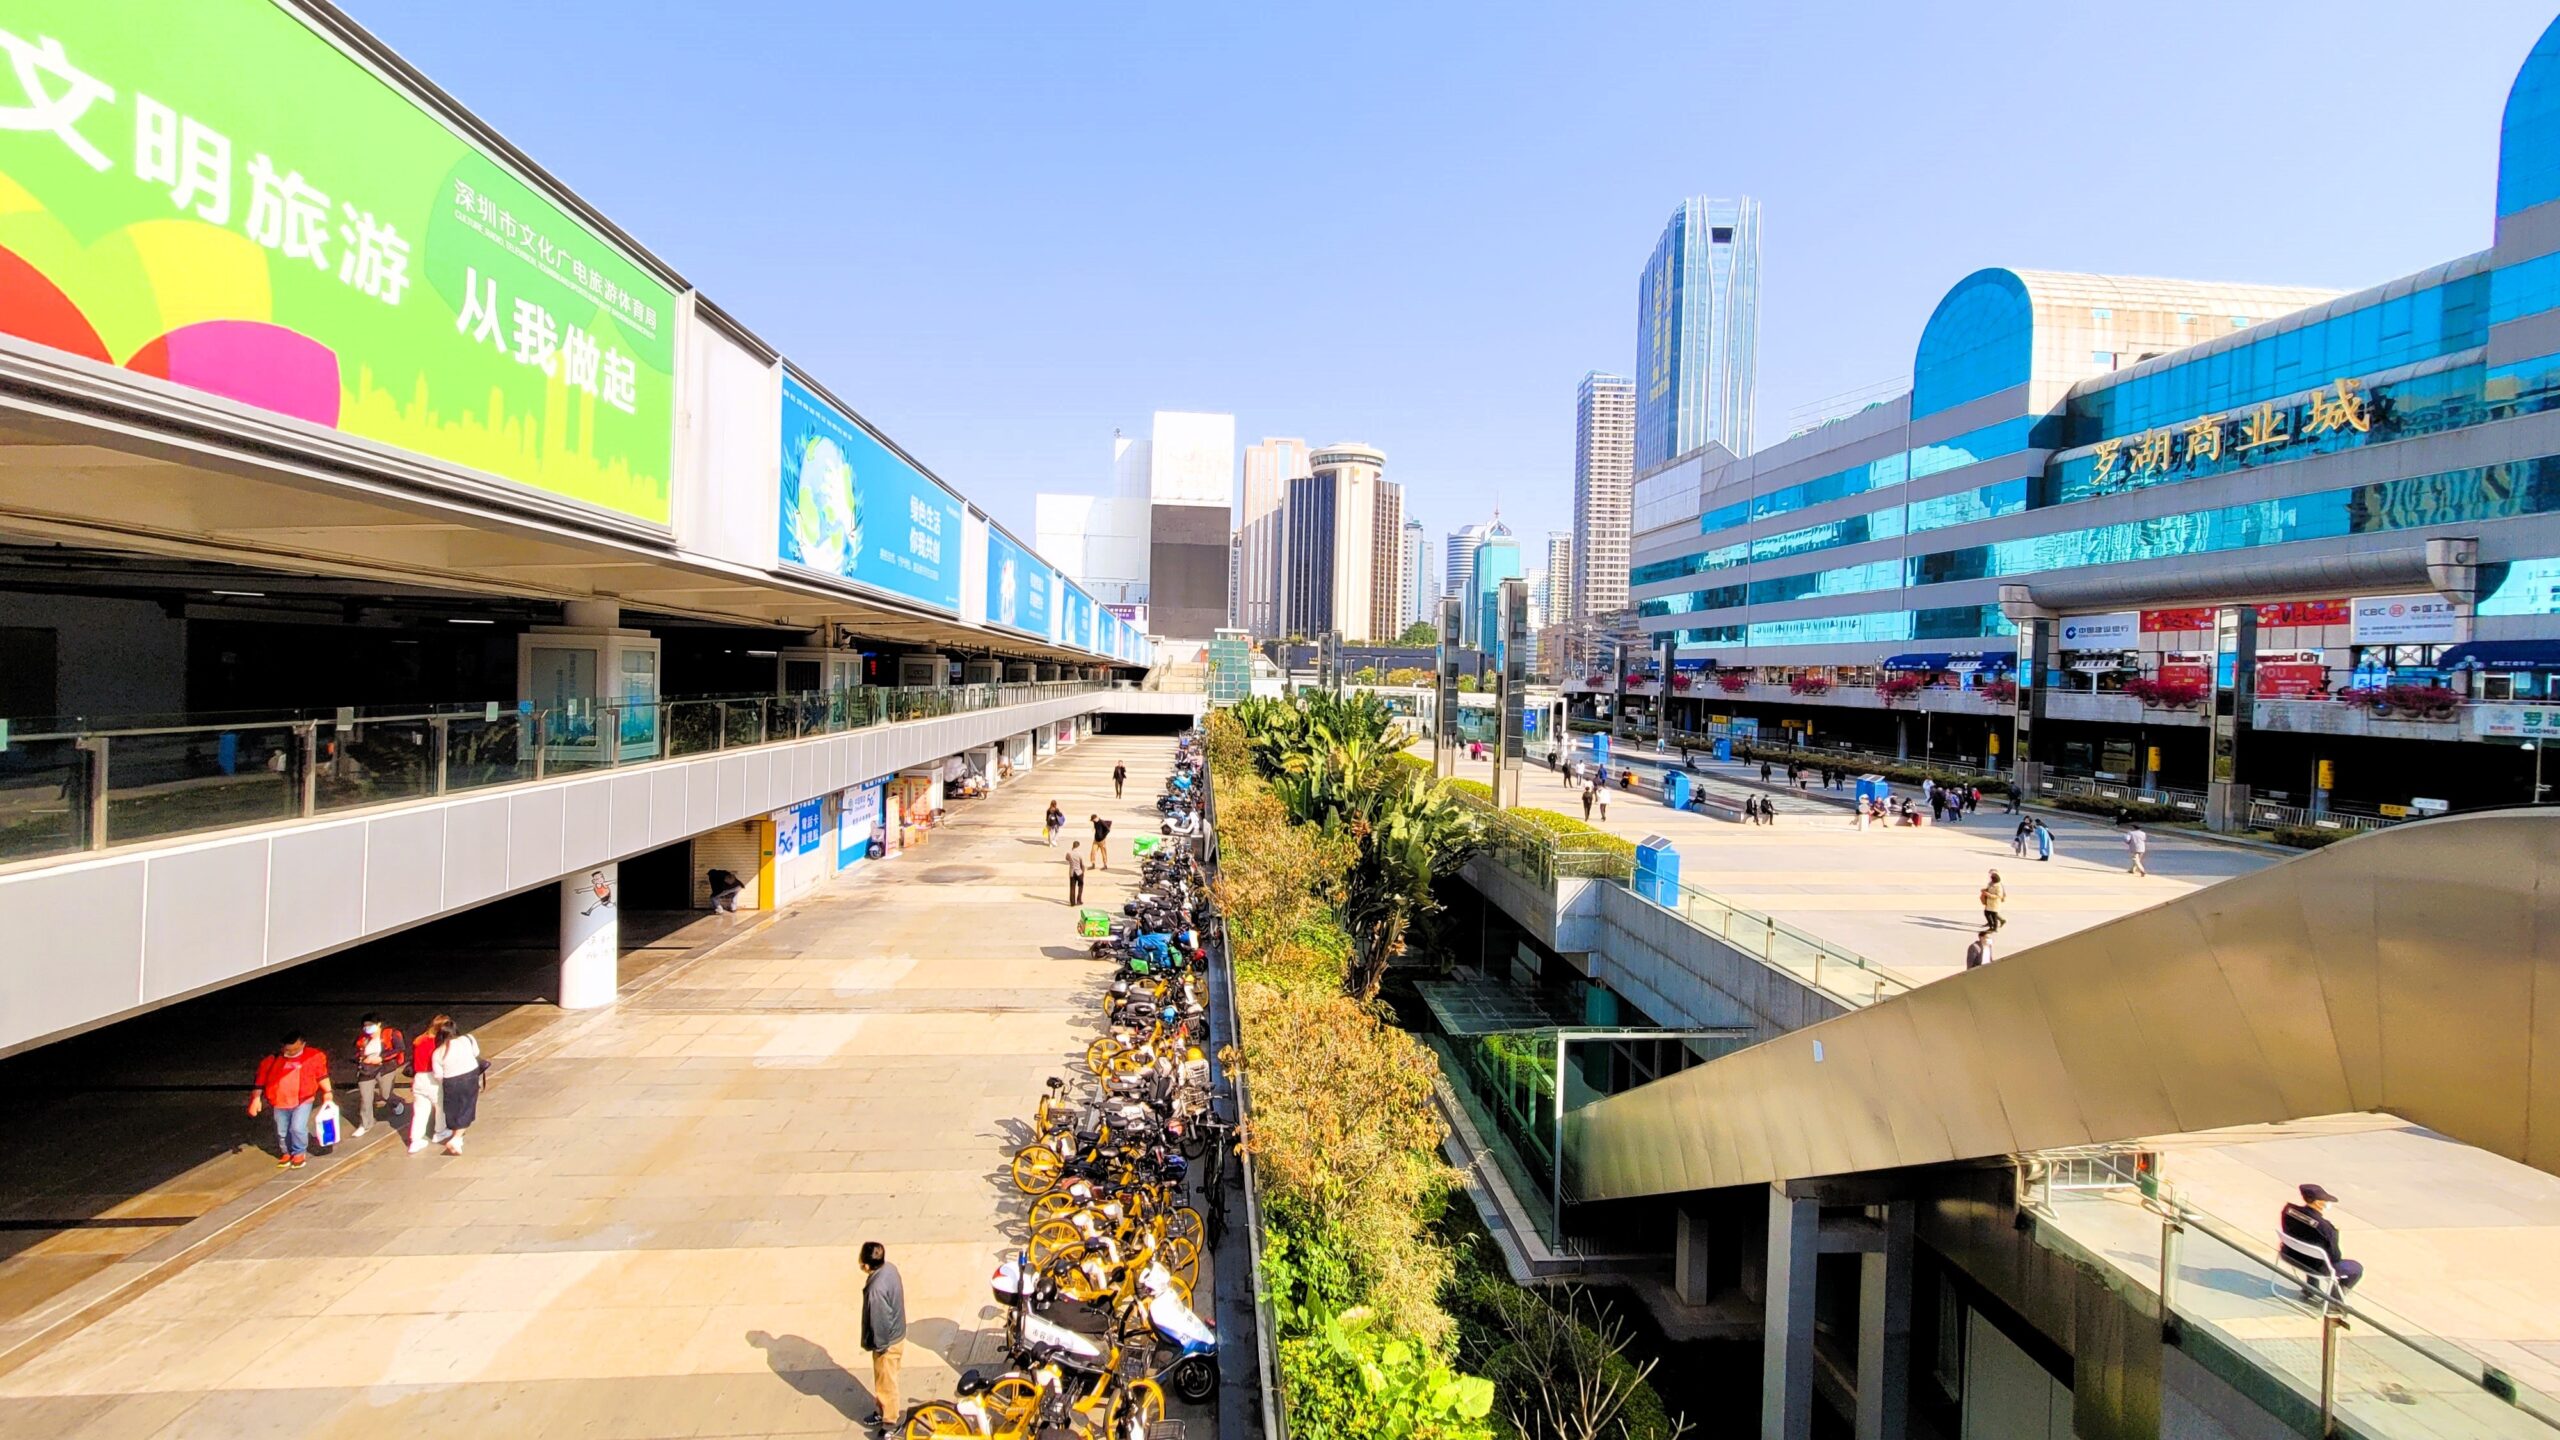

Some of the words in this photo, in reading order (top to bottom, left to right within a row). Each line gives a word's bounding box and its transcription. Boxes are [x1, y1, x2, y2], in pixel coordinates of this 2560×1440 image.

[0, 26, 411, 305] 文明旅游
[454, 178, 657, 330] 深圳市文化广电旅游体育局
[456, 266, 636, 415] 从我做起
[2091, 378, 2371, 485] 罗湖商业城
[2078, 625, 2129, 635] 中国建设银行
[2300, 652, 2320, 664] City
[2360, 608, 2386, 616] ICBC
